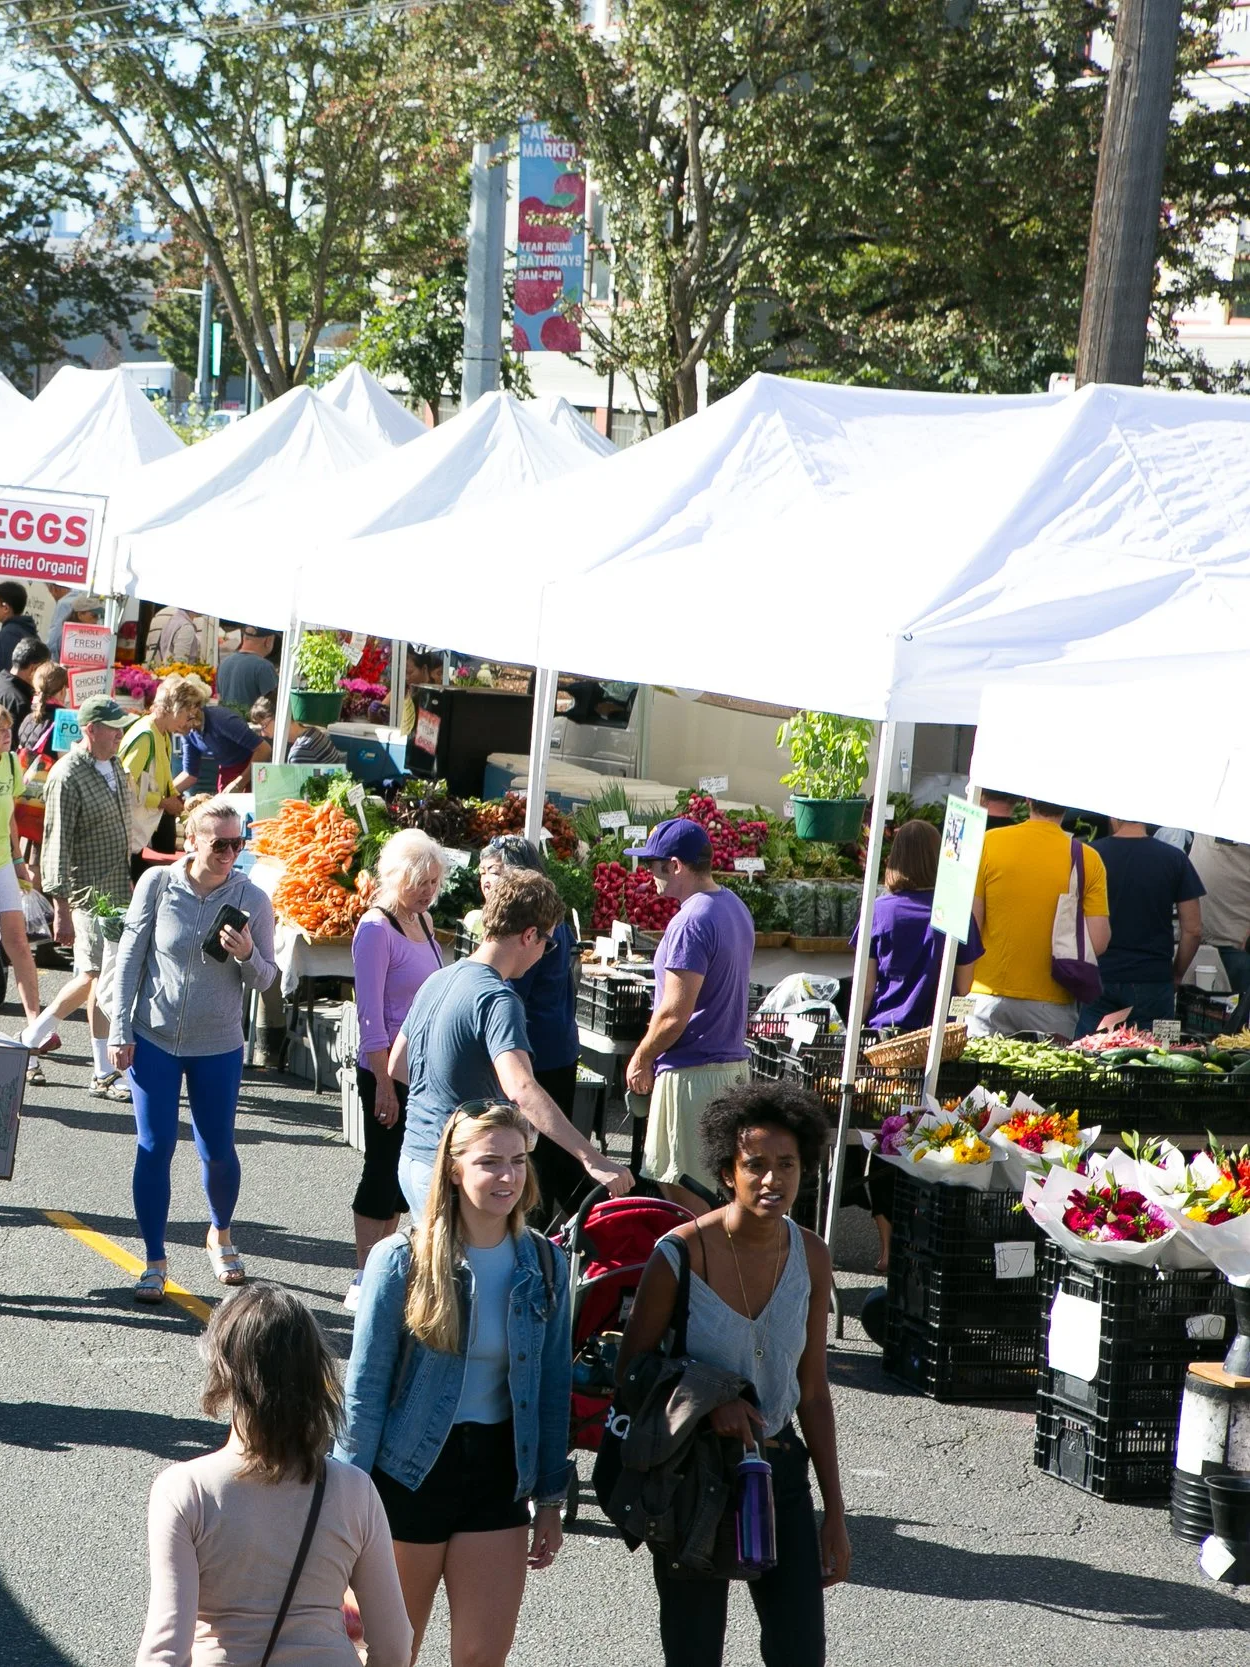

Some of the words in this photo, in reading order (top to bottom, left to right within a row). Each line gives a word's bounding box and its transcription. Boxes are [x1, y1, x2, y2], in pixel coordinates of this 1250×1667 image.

[522, 142, 577, 159] MARKET
[520, 241, 544, 252] YEAR
[546, 241, 573, 252] ROUND
[519, 254, 582, 267] SATURDAYS
[518, 270, 562, 281] 9AM-2PM
[36, 556, 84, 577] Organic
[74, 638, 102, 649] FRESH
[67, 652, 105, 663] CHICKEN
[75, 675, 106, 688] CHICKEN
[60, 722, 82, 735] PO
[996, 1246, 1030, 1275] $7
[1187, 1315, 1223, 1339] $10
